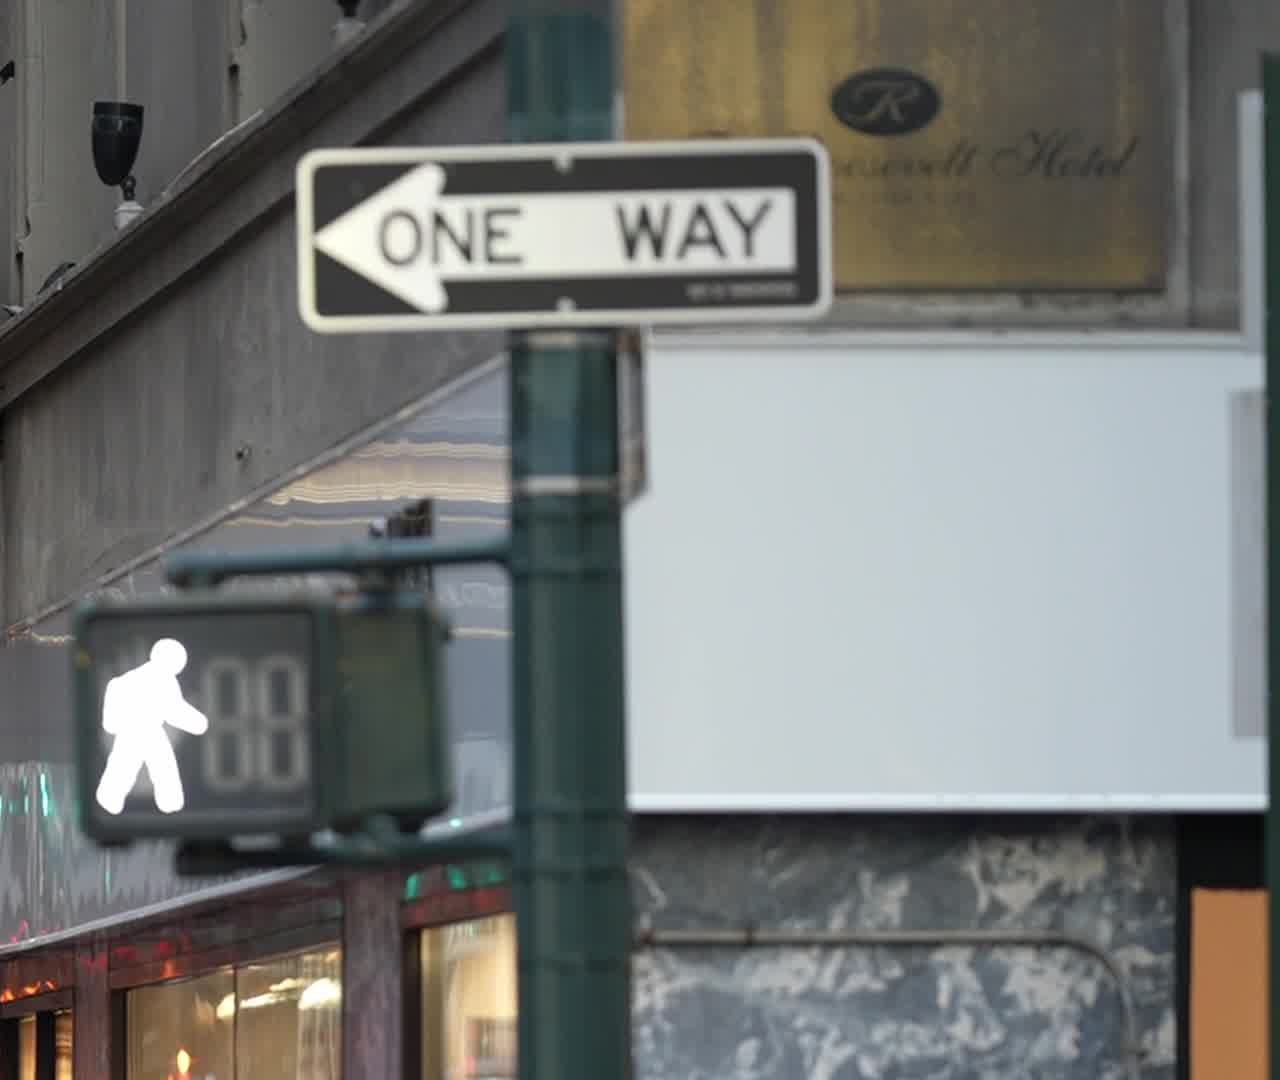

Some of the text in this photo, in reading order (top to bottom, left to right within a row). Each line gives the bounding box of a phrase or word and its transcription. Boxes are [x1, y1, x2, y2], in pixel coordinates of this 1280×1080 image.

[991, 130, 1139, 179] Hotel
[378, 198, 773, 268] ONE WAY
